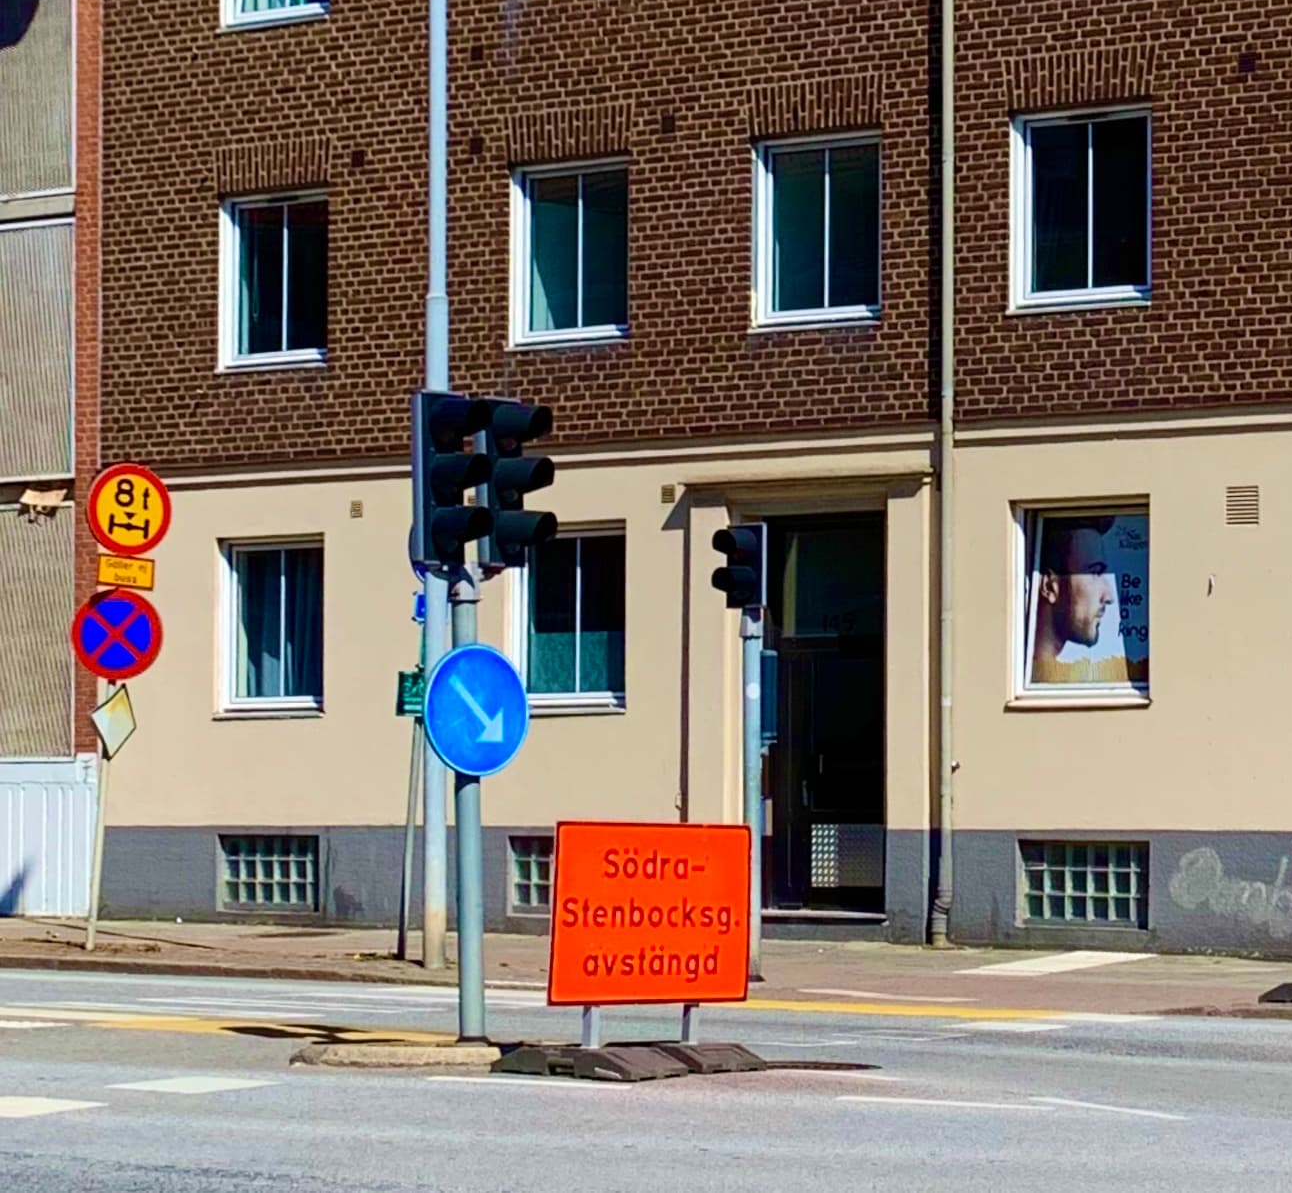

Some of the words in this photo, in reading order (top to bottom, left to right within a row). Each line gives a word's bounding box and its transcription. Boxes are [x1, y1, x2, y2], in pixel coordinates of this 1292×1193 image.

[115, 478, 135, 507] 8
[1121, 573, 1142, 588] Be
[603, 847, 705, 880] Södra-
[561, 897, 740, 935] Stenbocksg.
[582, 945, 720, 983] avstängd
